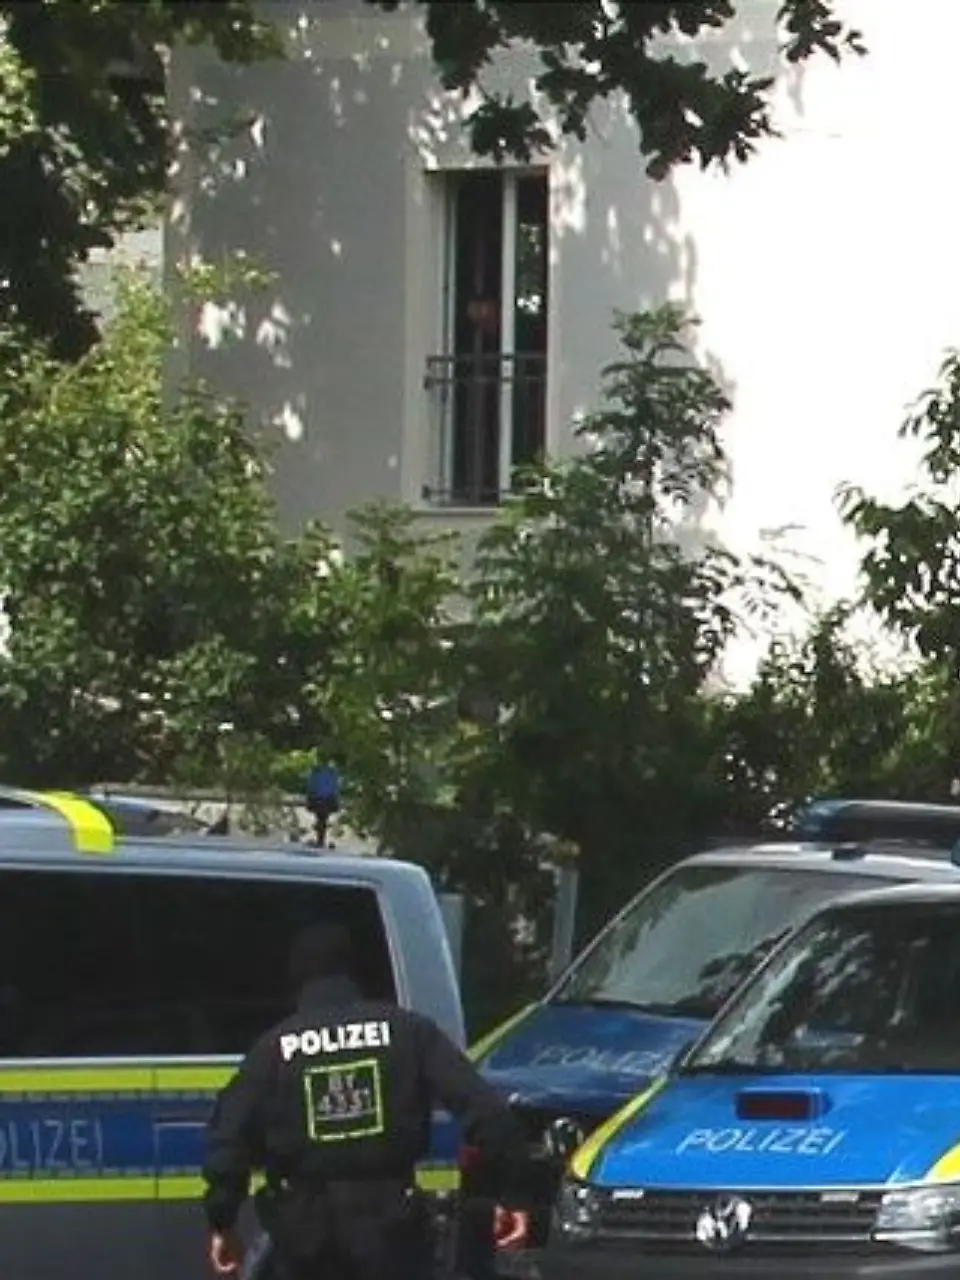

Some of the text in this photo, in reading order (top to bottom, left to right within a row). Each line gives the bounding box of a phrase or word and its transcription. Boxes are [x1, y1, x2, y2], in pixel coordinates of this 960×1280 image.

[280, 1021, 390, 1060] POLIZEI
[0, 1119, 103, 1167] LIZEI
[675, 1127, 849, 1155] POLIZEI
